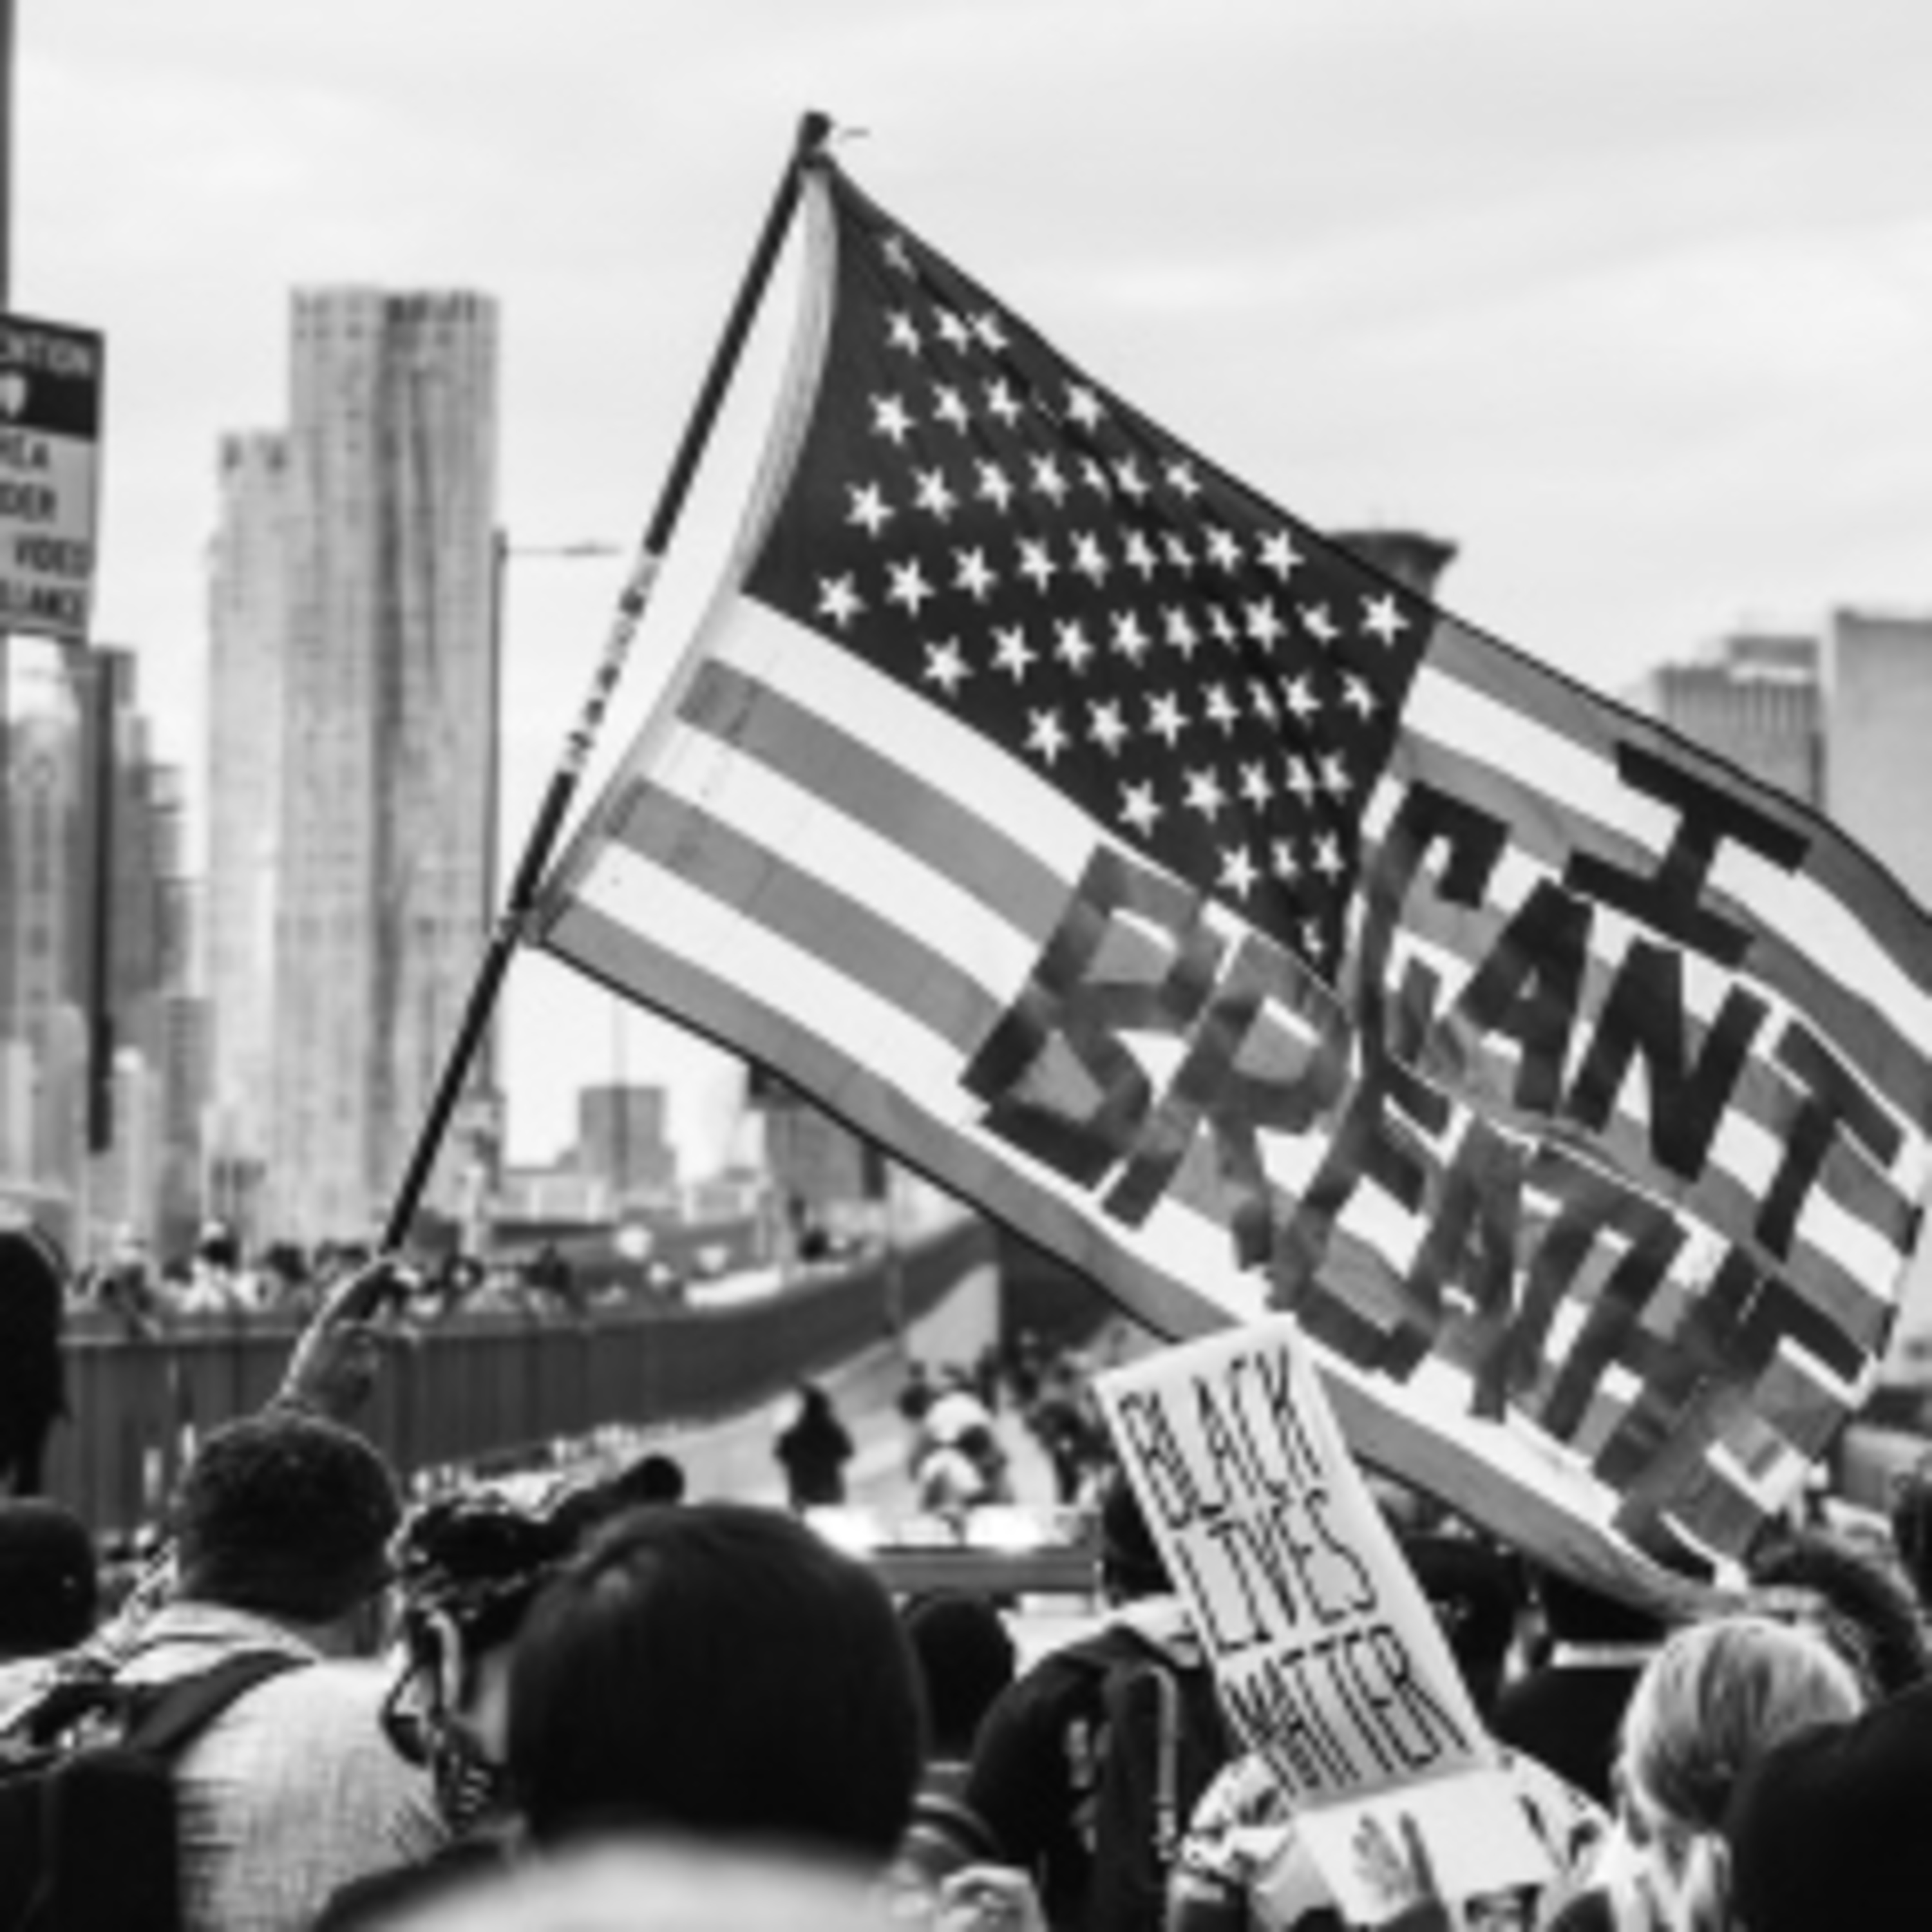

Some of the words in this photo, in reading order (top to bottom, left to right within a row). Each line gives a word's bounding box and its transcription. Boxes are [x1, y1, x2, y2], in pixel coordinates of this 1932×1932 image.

[1562, 738, 1811, 967] I
[1117, 1342, 1323, 1531] BLACK
[1172, 1485, 1378, 1655] LIVES
[1222, 1622, 1475, 1795] MATTER
